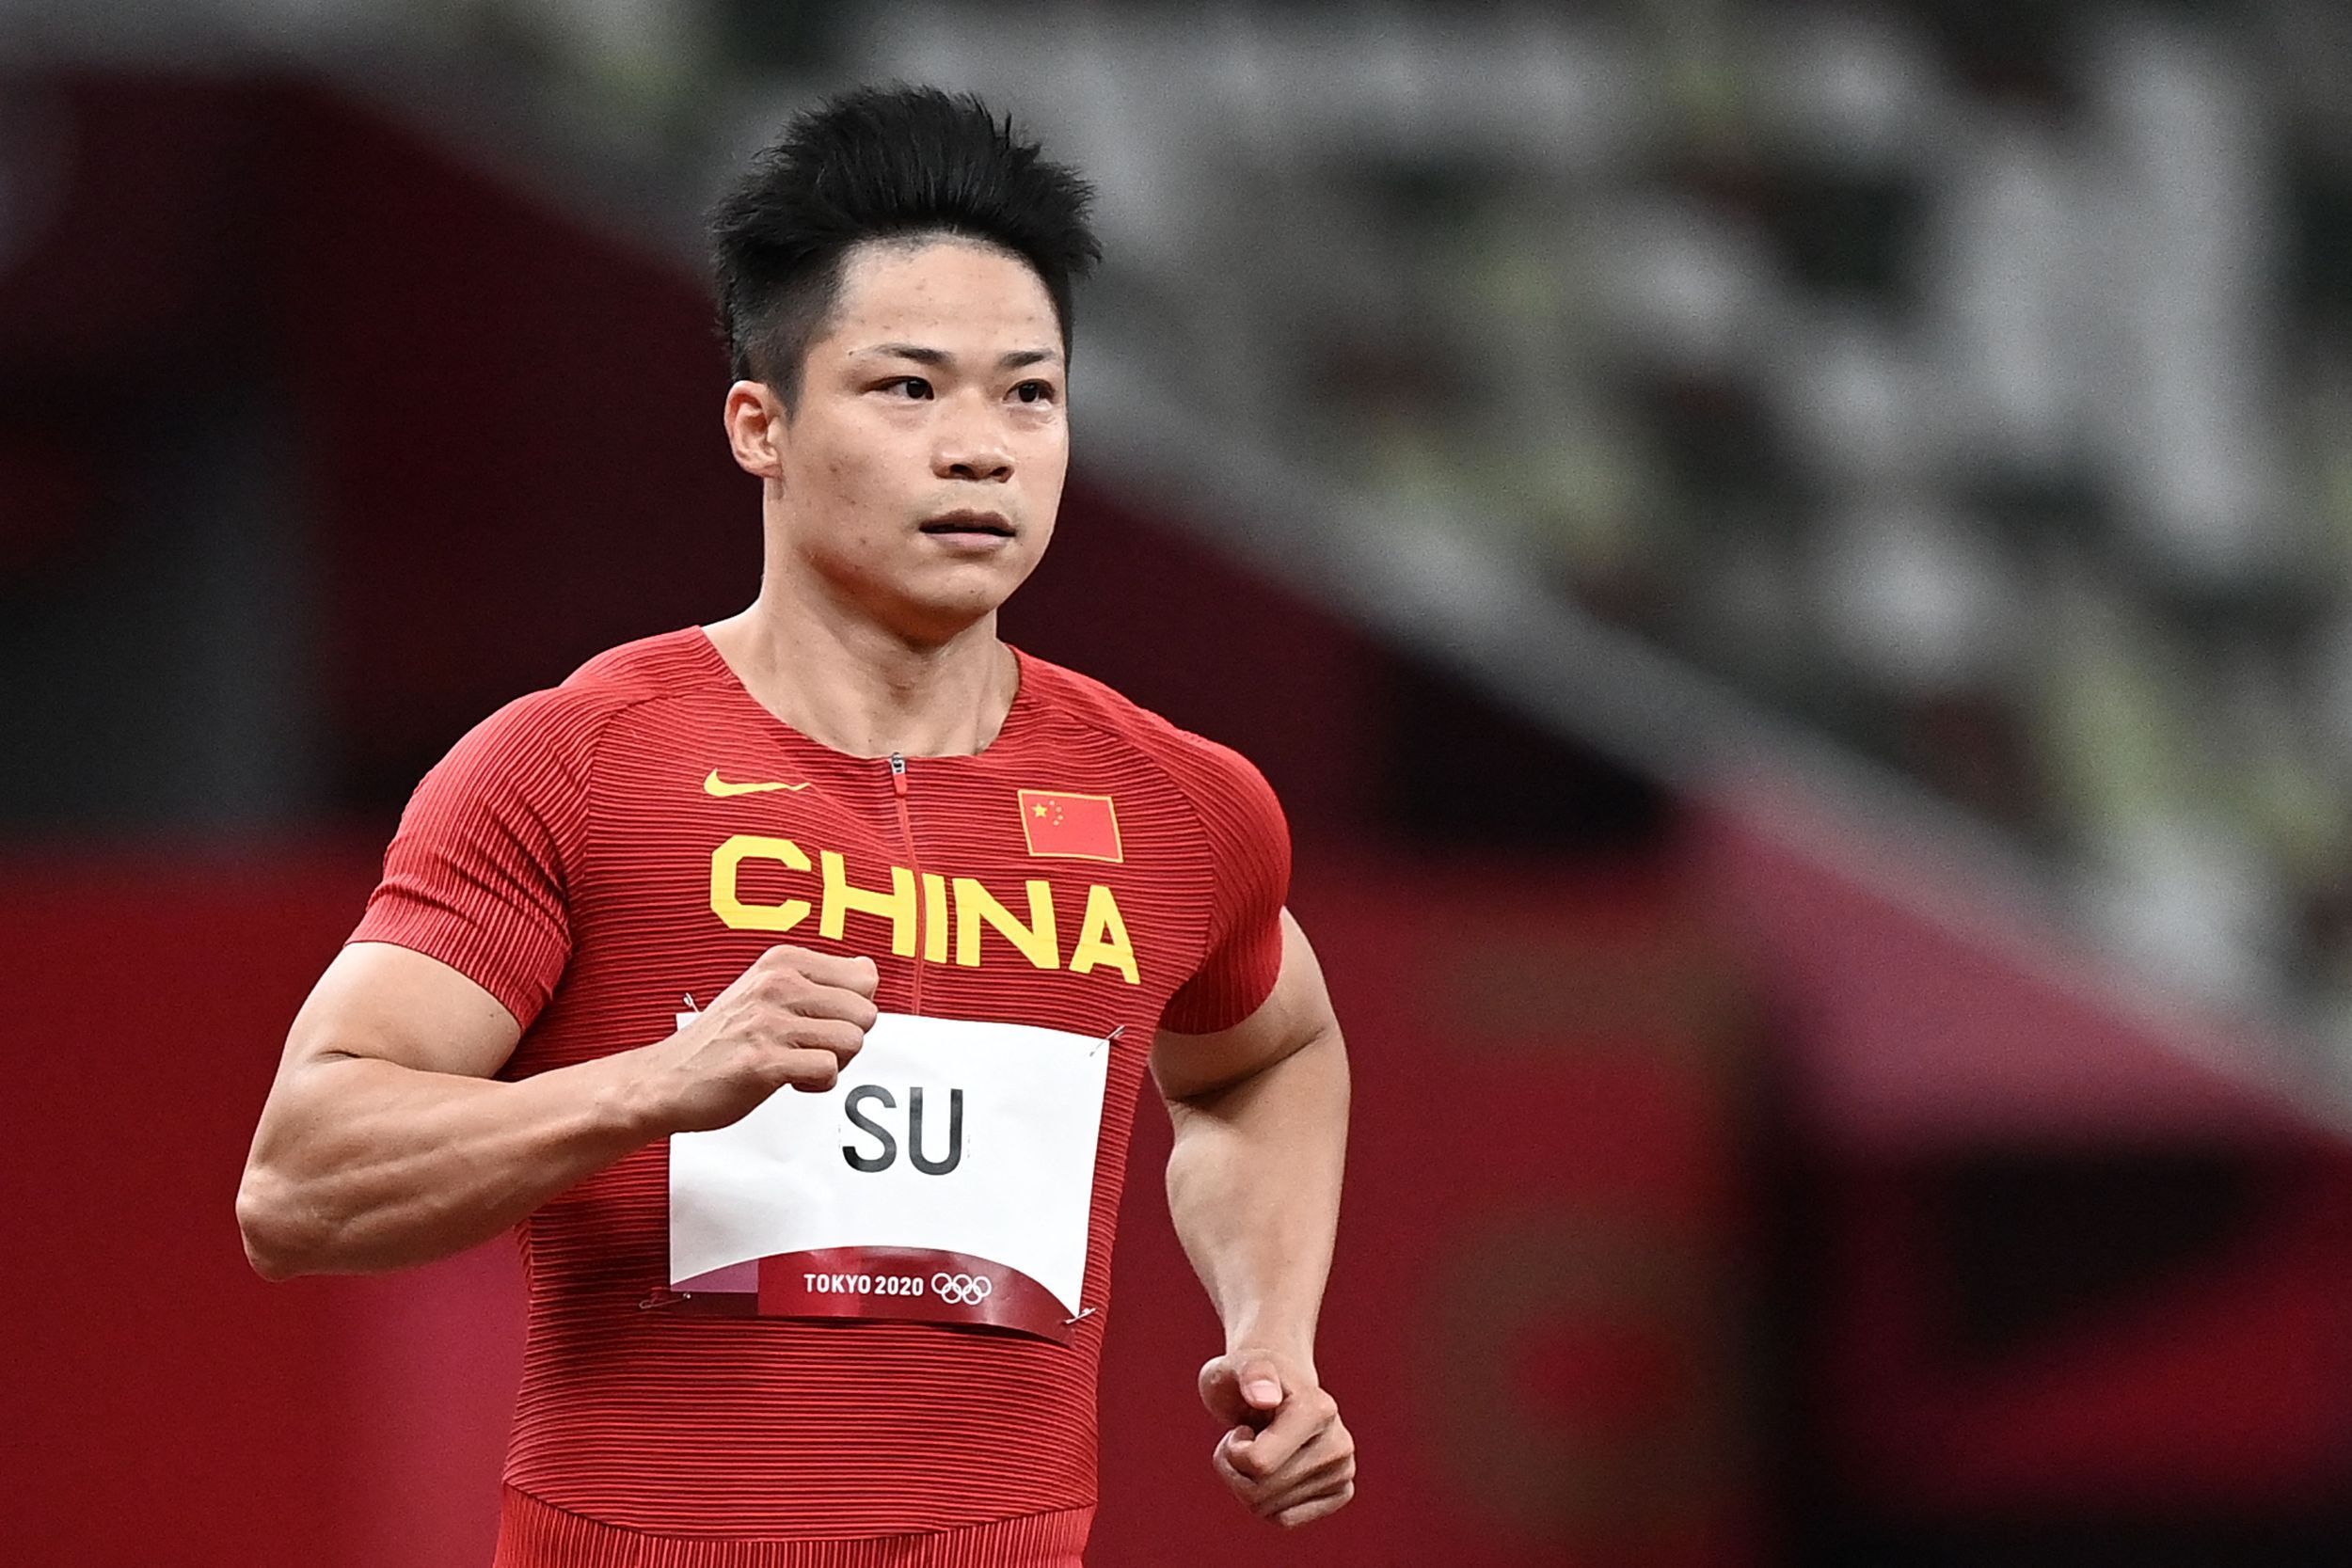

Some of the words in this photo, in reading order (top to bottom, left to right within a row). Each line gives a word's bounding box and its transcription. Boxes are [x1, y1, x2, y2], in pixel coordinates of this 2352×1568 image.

[710, 834, 1140, 985] CHINA
[842, 1085, 963, 1176] SU
[803, 1274, 871, 1294] TOKYO
[874, 1275, 924, 1296] 2020
